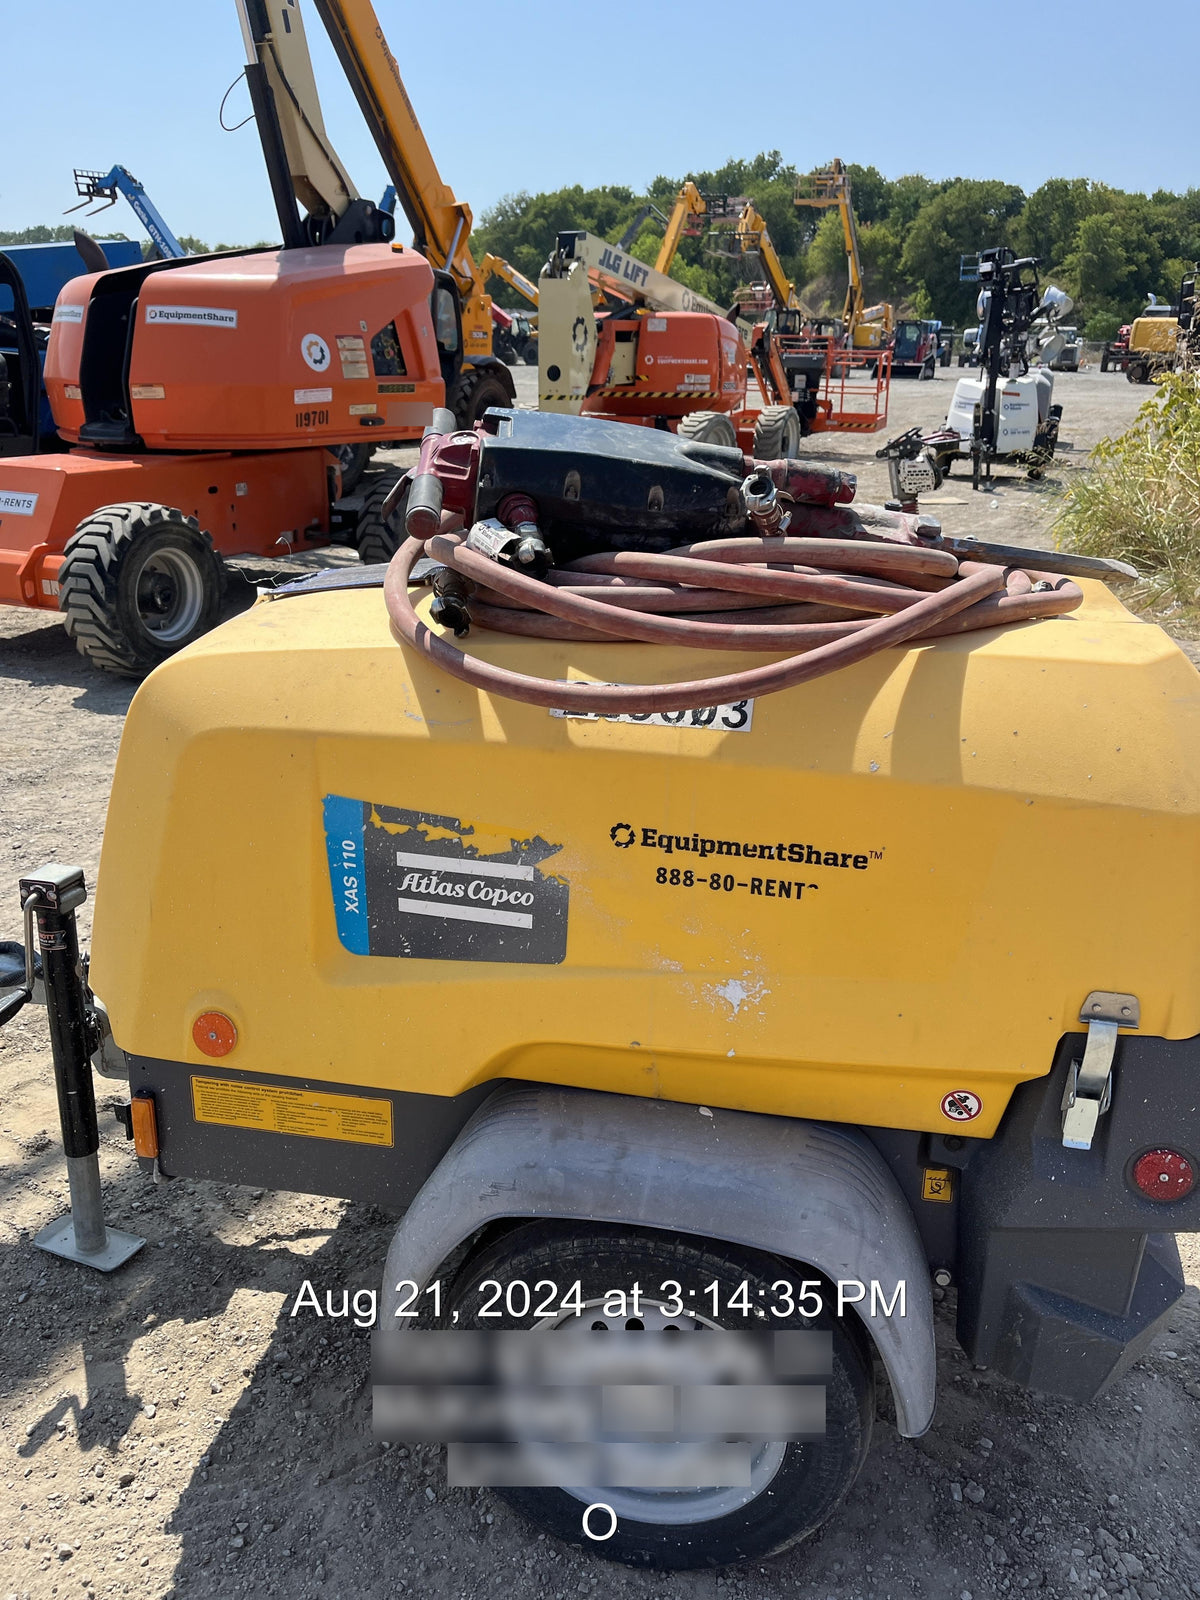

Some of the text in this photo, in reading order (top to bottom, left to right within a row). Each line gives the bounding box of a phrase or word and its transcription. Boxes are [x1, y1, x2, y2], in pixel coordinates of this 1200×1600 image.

[598, 248, 650, 288] JLG LIFT
[158, 309, 235, 323] EquipmentShare
[295, 409, 330, 428] 119701
[0, 497, 33, 509] -RENTS
[640, 827, 869, 870] EquipmentShare
[341, 839, 360, 915] XAS 110
[655, 866, 820, 901] 888-80-RENT
[466, 880, 534, 907] Copco
